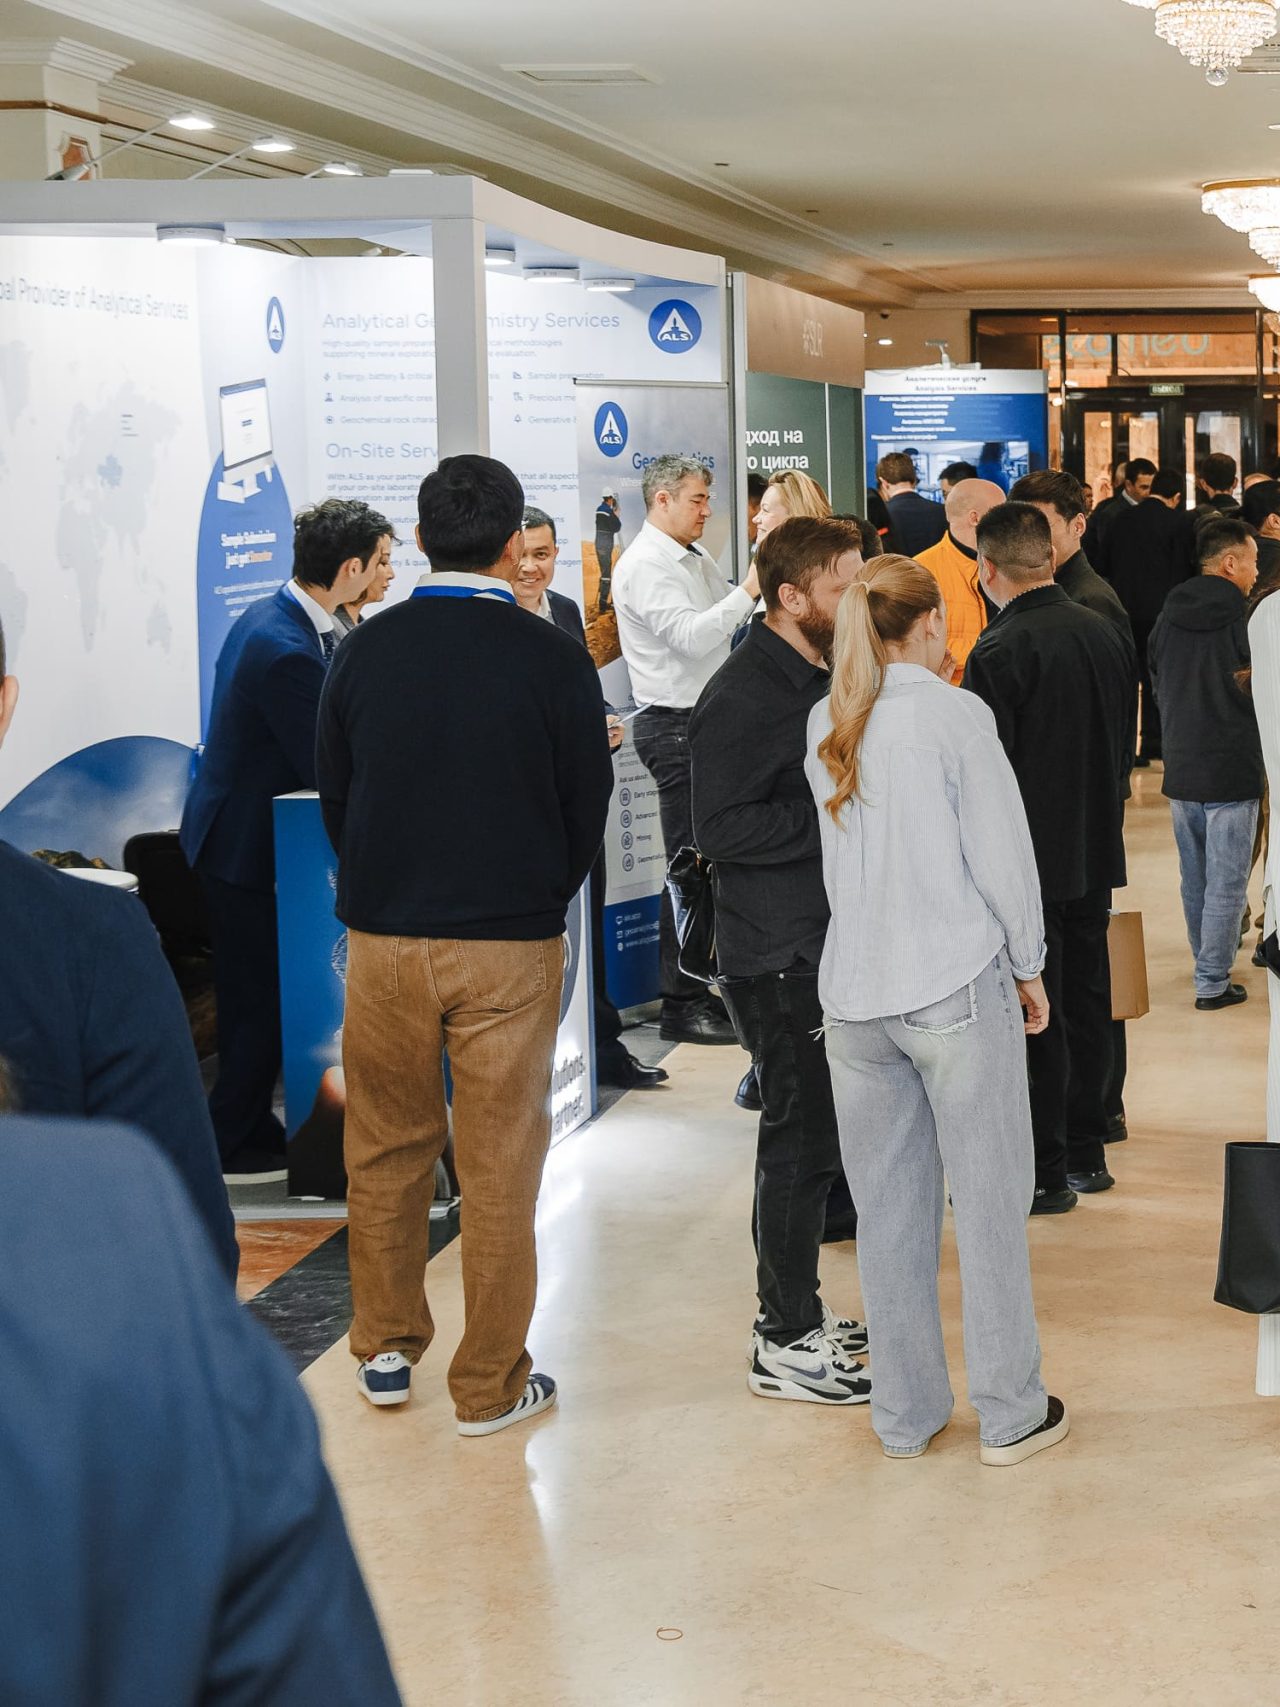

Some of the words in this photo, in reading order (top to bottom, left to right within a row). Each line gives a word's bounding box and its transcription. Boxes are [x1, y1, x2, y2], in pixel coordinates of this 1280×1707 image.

[19, 277, 70, 307] Provider
[89, 286, 142, 318] Analytical
[146, 292, 190, 320] Services
[322, 313, 409, 332] Analytical
[545, 311, 620, 329] Services
[661, 333, 689, 341] ALS
[603, 436, 621, 444] ALS
[783, 430, 804, 444] на
[326, 442, 395, 458] On-Site
[761, 455, 810, 474] цикла
